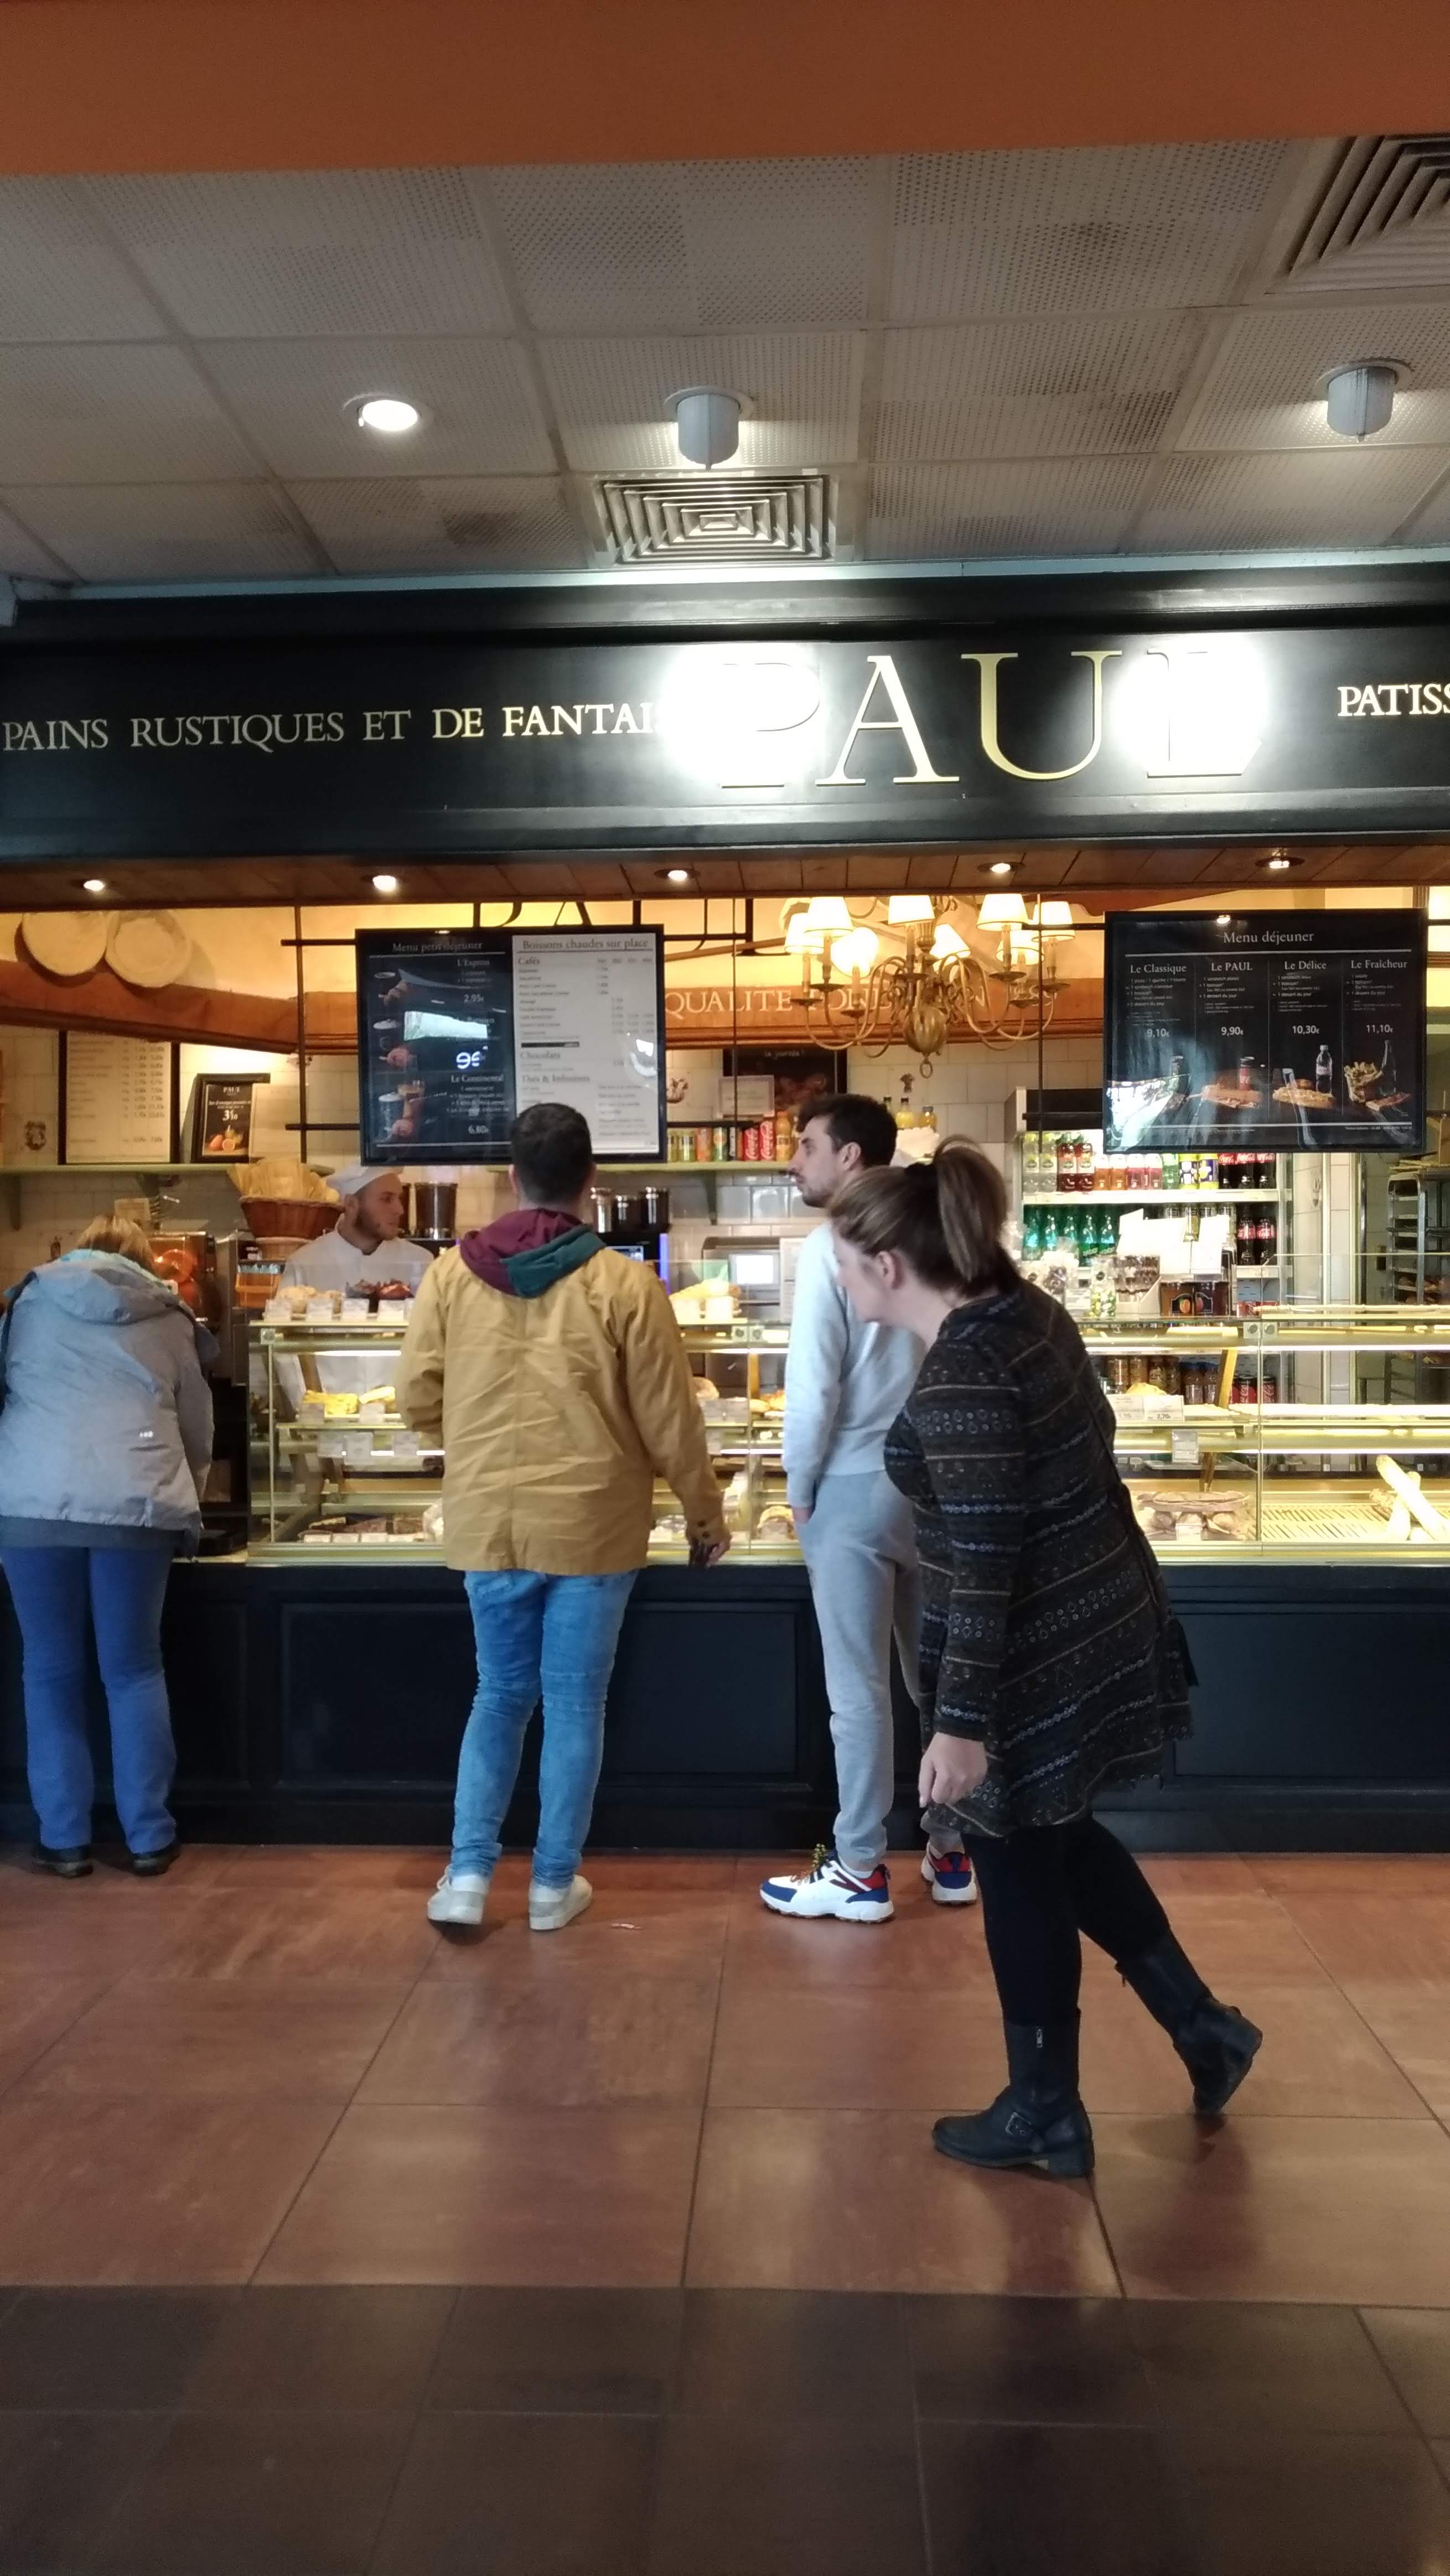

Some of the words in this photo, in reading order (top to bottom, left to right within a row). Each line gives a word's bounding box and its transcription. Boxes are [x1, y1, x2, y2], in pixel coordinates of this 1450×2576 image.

[722, 648, 1263, 788] PAUL
[3, 719, 108, 751] PAINS
[130, 712, 344, 753] RUSTIQUES
[362, 709, 411, 741] ET
[432, 708, 484, 739] DE
[502, 702, 661, 737] FANTAI
[1224, 932, 1258, 943] Menu
[1262, 931, 1314, 945] déjeuner
[393, 943, 418, 952] Menu
[522, 940, 563, 949] Boissons
[566, 938, 603, 948] chaudes
[624, 939, 648, 950] place
[518, 957, 540, 965] Cafés
[1284, 961, 1296, 970] Le
[1298, 960, 1327, 969] Délice
[1350, 960, 1362, 969] Le
[1130, 964, 1141, 973] Le
[1143, 964, 1187, 975] Classique
[1211, 963, 1223, 972] Le
[1225, 962, 1253, 972] PAUL
[665, 990, 793, 1019] QUALITE
